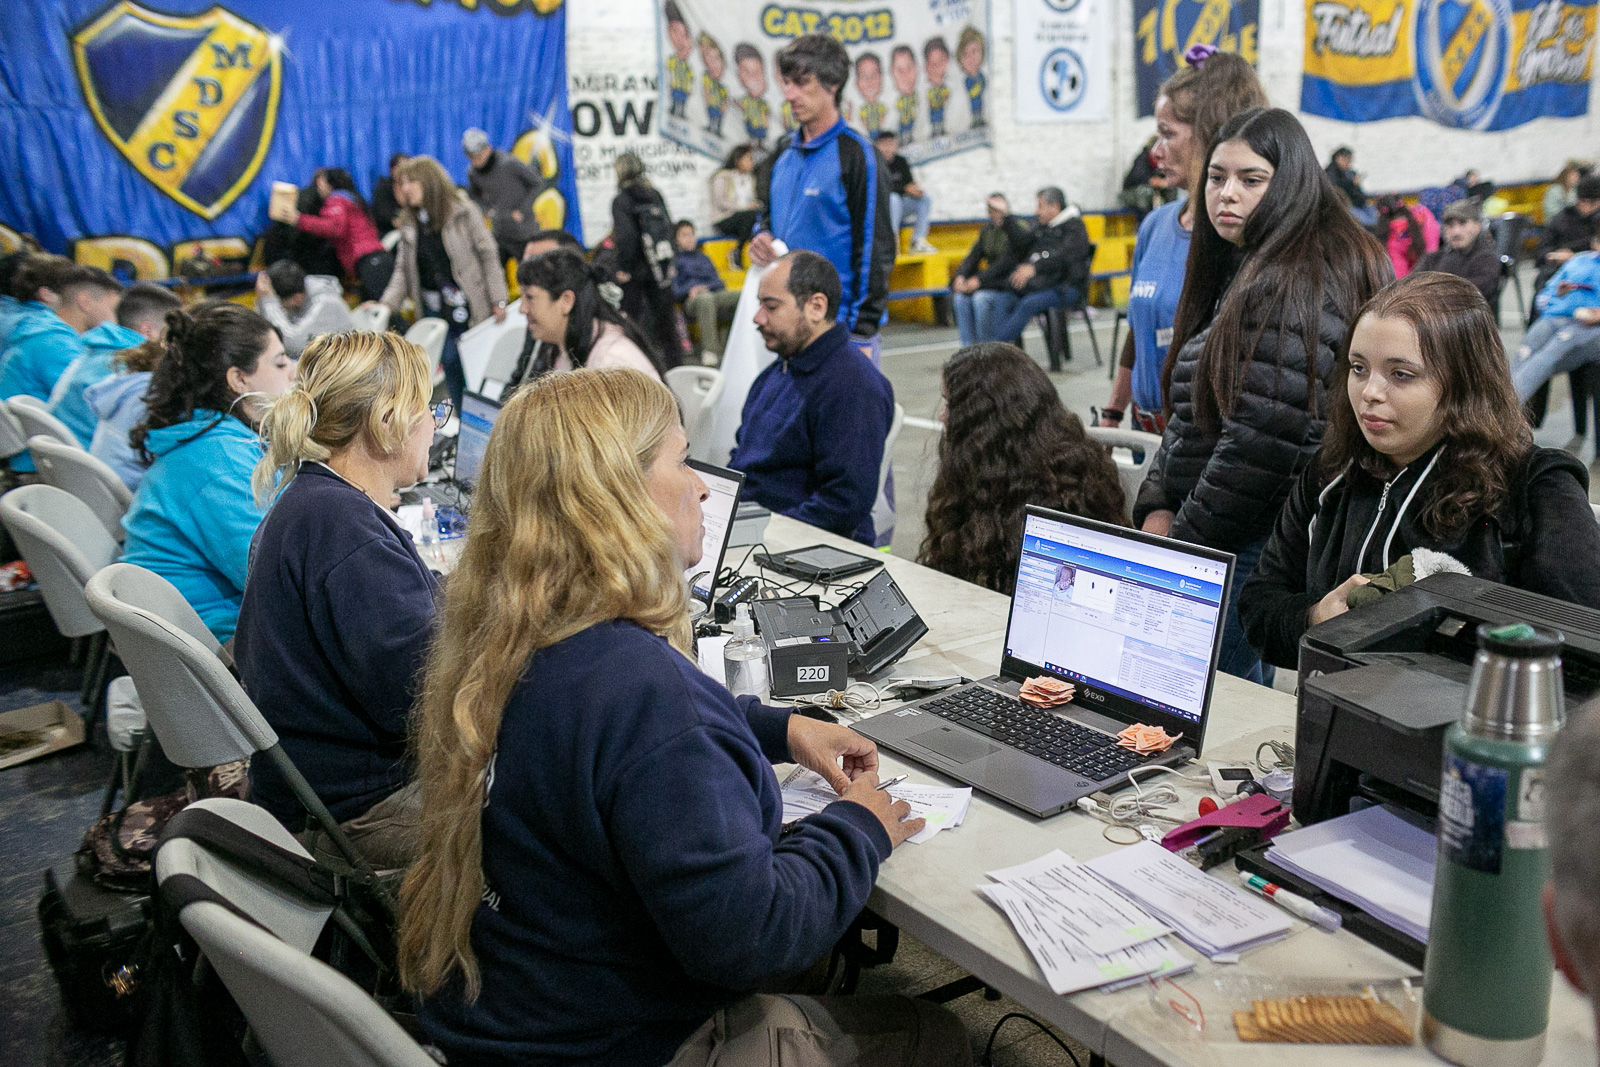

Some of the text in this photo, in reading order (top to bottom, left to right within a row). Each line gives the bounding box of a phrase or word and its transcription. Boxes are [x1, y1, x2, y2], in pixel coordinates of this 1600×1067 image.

[828, 9, 894, 43] 2012
[799, 667, 826, 680] 220
[1090, 692, 1105, 702] EXO
